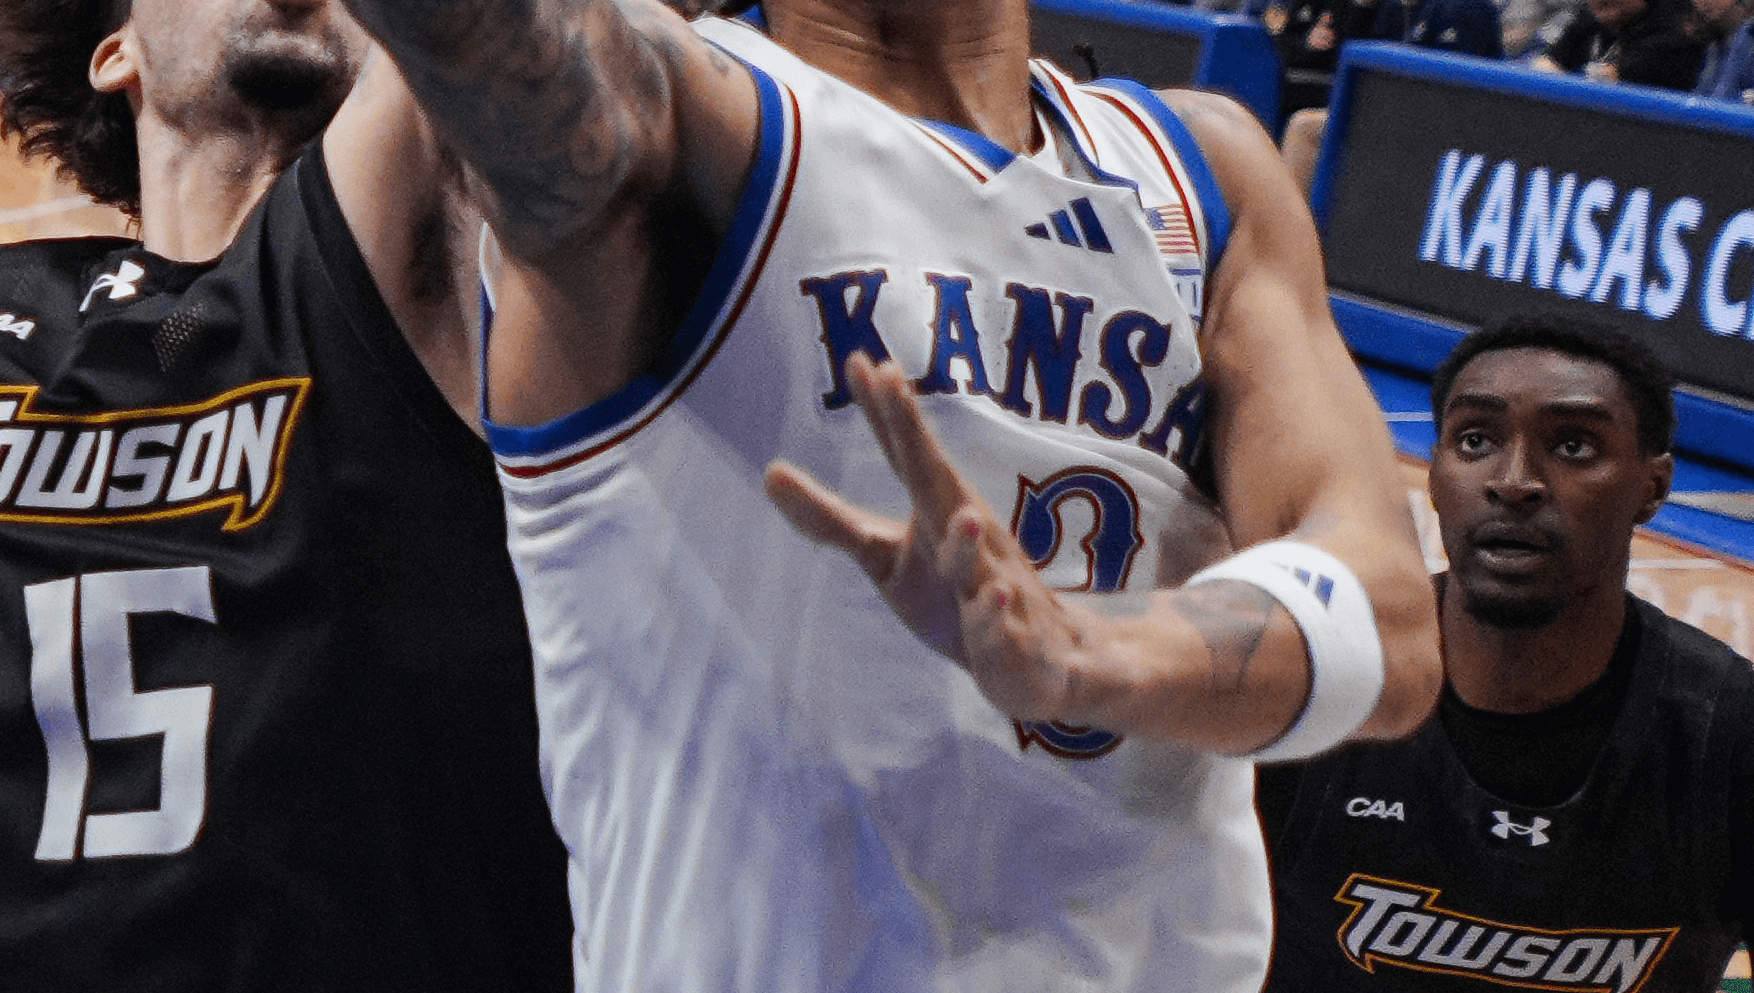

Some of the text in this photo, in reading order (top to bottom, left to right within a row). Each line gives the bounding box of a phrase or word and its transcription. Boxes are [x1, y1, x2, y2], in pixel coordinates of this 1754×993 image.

[1419, 148, 1754, 342] KANSAS C
[799, 269, 1206, 464] KANSA
[23, 565, 217, 862] 15
[1346, 796, 1405, 822] CAA
[1345, 883, 1662, 993] TOWSON
